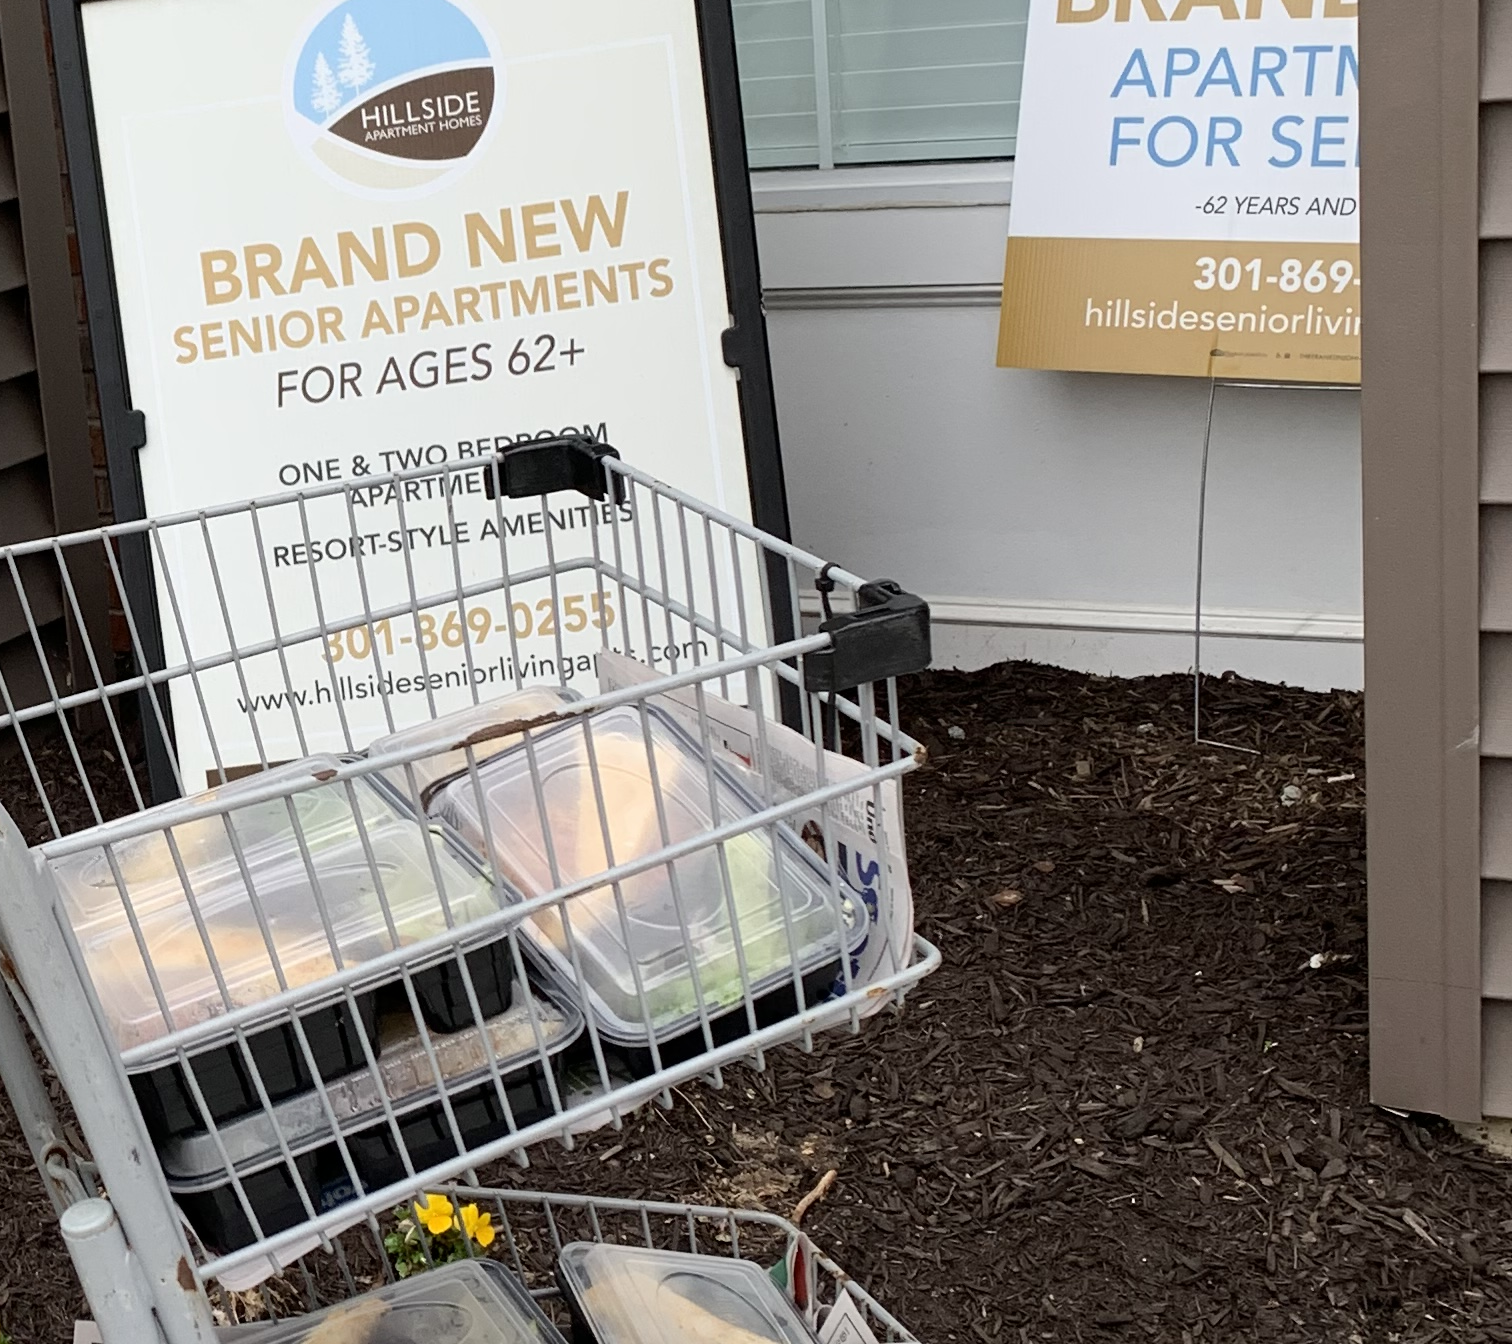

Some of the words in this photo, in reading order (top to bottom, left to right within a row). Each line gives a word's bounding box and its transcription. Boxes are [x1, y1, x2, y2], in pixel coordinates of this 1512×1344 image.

[360, 91, 480, 129] HILLSIDE
[364, 121, 436, 142] APARTMENT
[439, 114, 483, 131] HOMES
[1108, 115, 1243, 168] FOR
[1268, 115, 1360, 168] SE
[1194, 196, 1226, 216] -62
[1234, 196, 1299, 216] YEARS
[1305, 197, 1356, 217] AND
[199, 220, 442, 306] BRAND
[464, 190, 630, 268] NEW
[172, 306, 345, 365] SENIOR
[360, 257, 675, 339] APARTMENTS
[277, 361, 362, 408] FOR
[376, 343, 493, 394] AGES
[507, 332, 586, 377] 62+
[278, 458, 342, 486] ONE
[351, 455, 371, 477] &
[378, 444, 448, 473] TWO
[273, 522, 471, 568] RESORT-STYLE
[480, 500, 634, 543] AMENITIES
[321, 591, 616, 664] 301-869-0255
